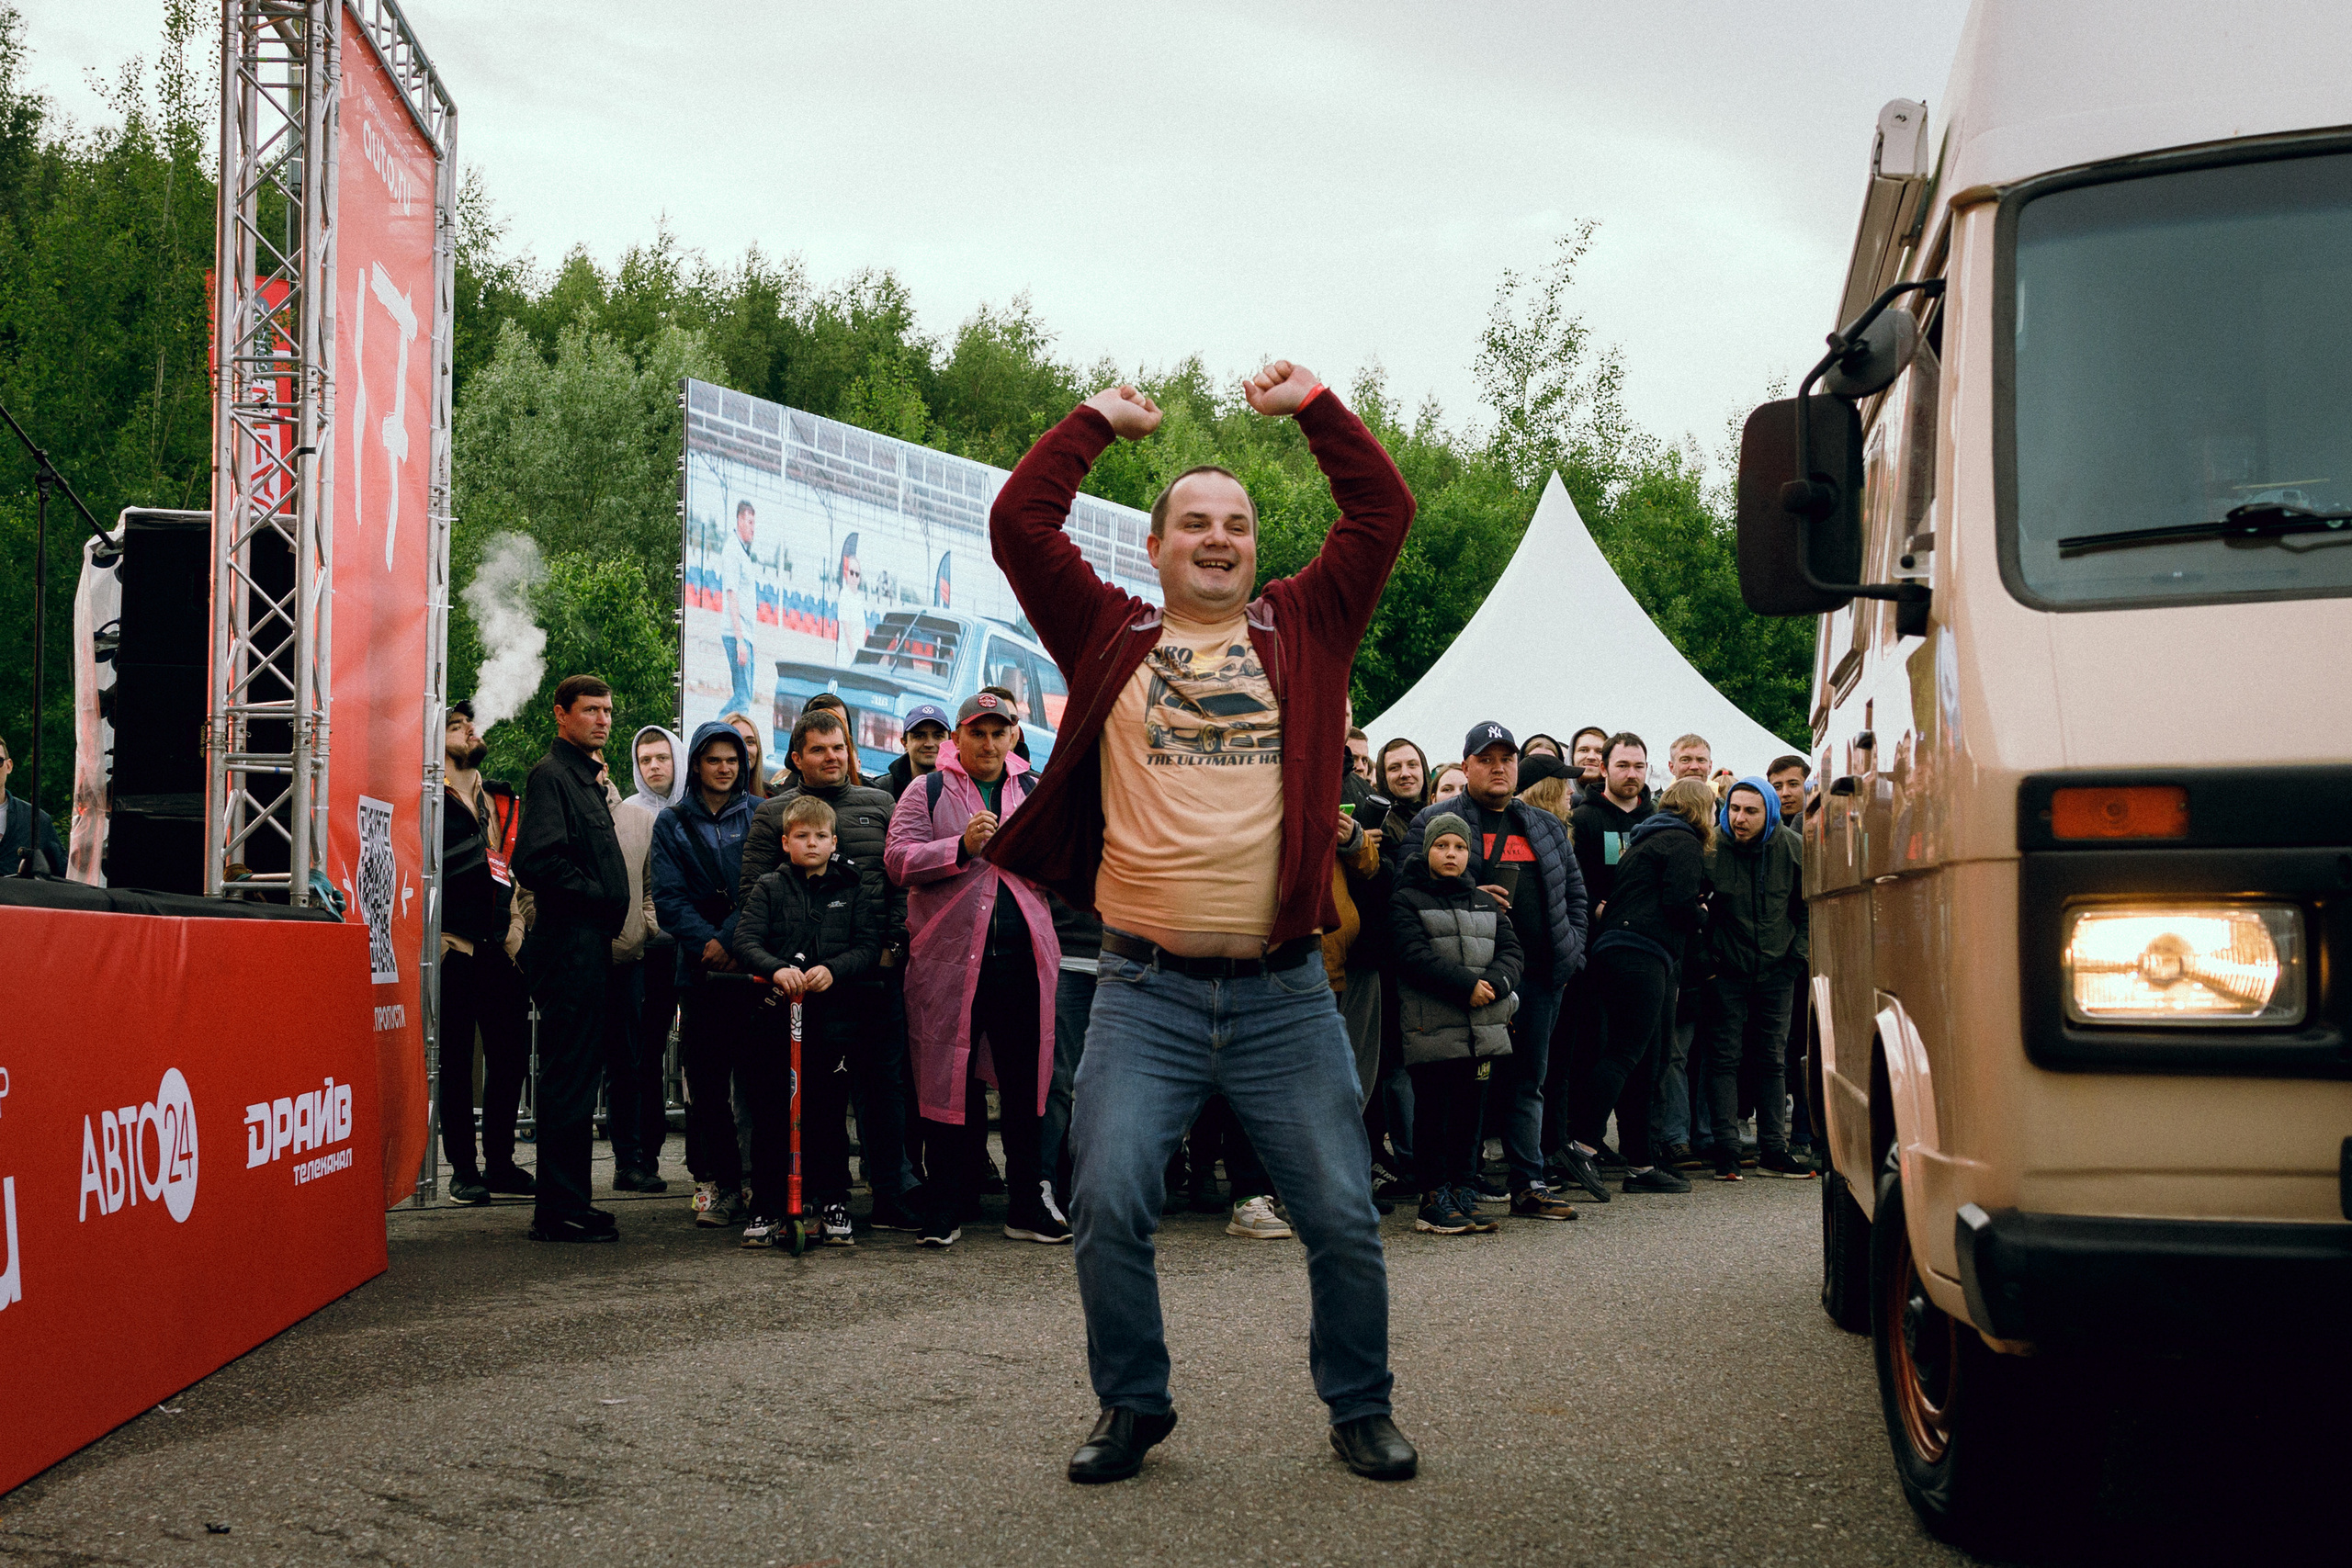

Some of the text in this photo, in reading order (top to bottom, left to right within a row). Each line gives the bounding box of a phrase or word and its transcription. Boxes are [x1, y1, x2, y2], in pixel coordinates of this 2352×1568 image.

[363, 119, 411, 217] auto.ru
[1487, 726, 1503, 739] NY
[1147, 754, 1173, 766] THE
[1177, 754, 1255, 766] ULTIMATE
[374, 1004, 406, 1032] ПРОПУСТИ
